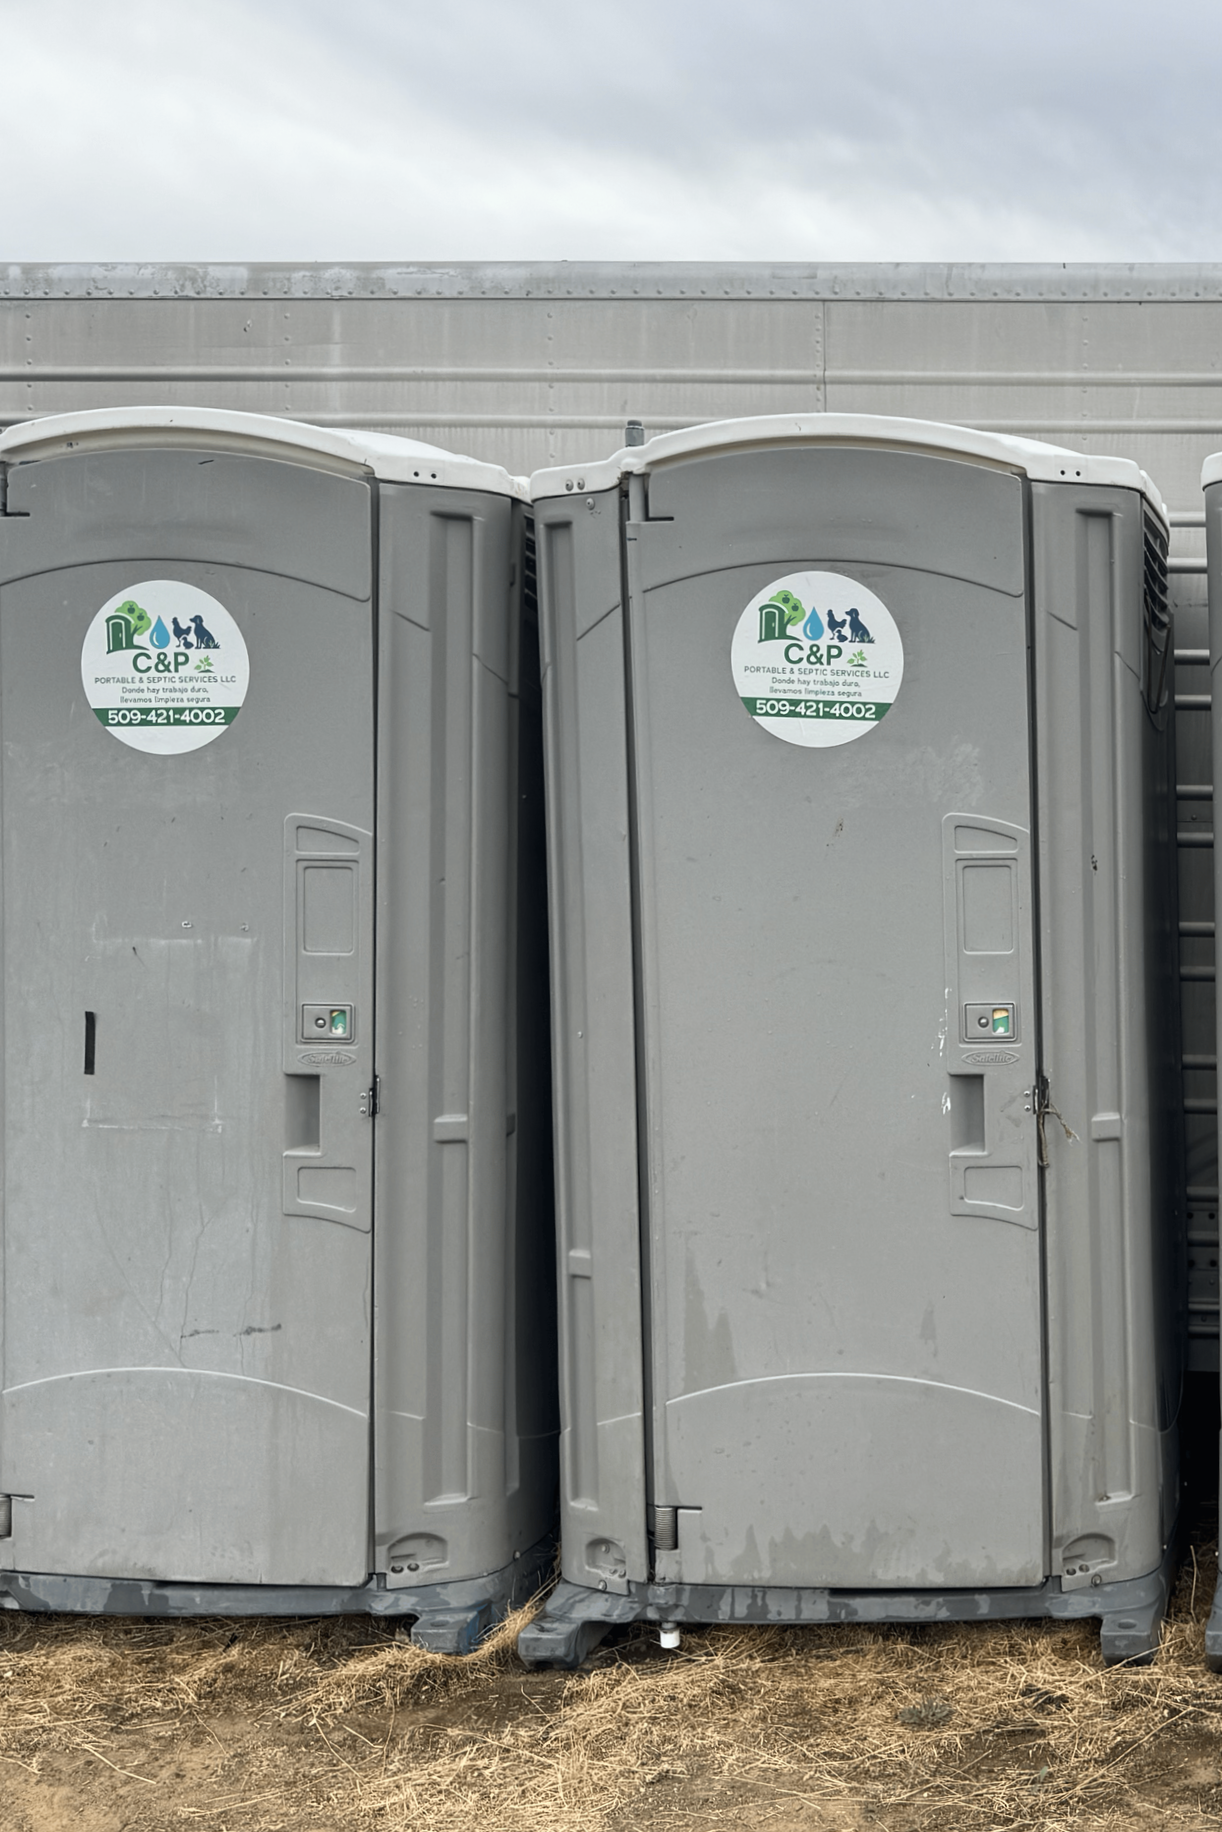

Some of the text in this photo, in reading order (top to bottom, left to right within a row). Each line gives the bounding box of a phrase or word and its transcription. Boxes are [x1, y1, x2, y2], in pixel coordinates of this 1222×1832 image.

[784, 643, 842, 666] C&P
[132, 652, 189, 673] C&P
[744, 666, 787, 674] PORTABLE
[798, 668, 828, 676] SEPTIC
[830, 669, 871, 678] SERVICES
[221, 675, 236, 683] LLC
[772, 677, 860, 687] Donde hay trabajo duro,
[804, 688, 835, 696] limpieza
[838, 690, 862, 698] segura
[756, 700, 876, 718] 509-421-4002
[108, 709, 225, 724] 509-421-4002
[971, 1051, 1012, 1063] Satellite
